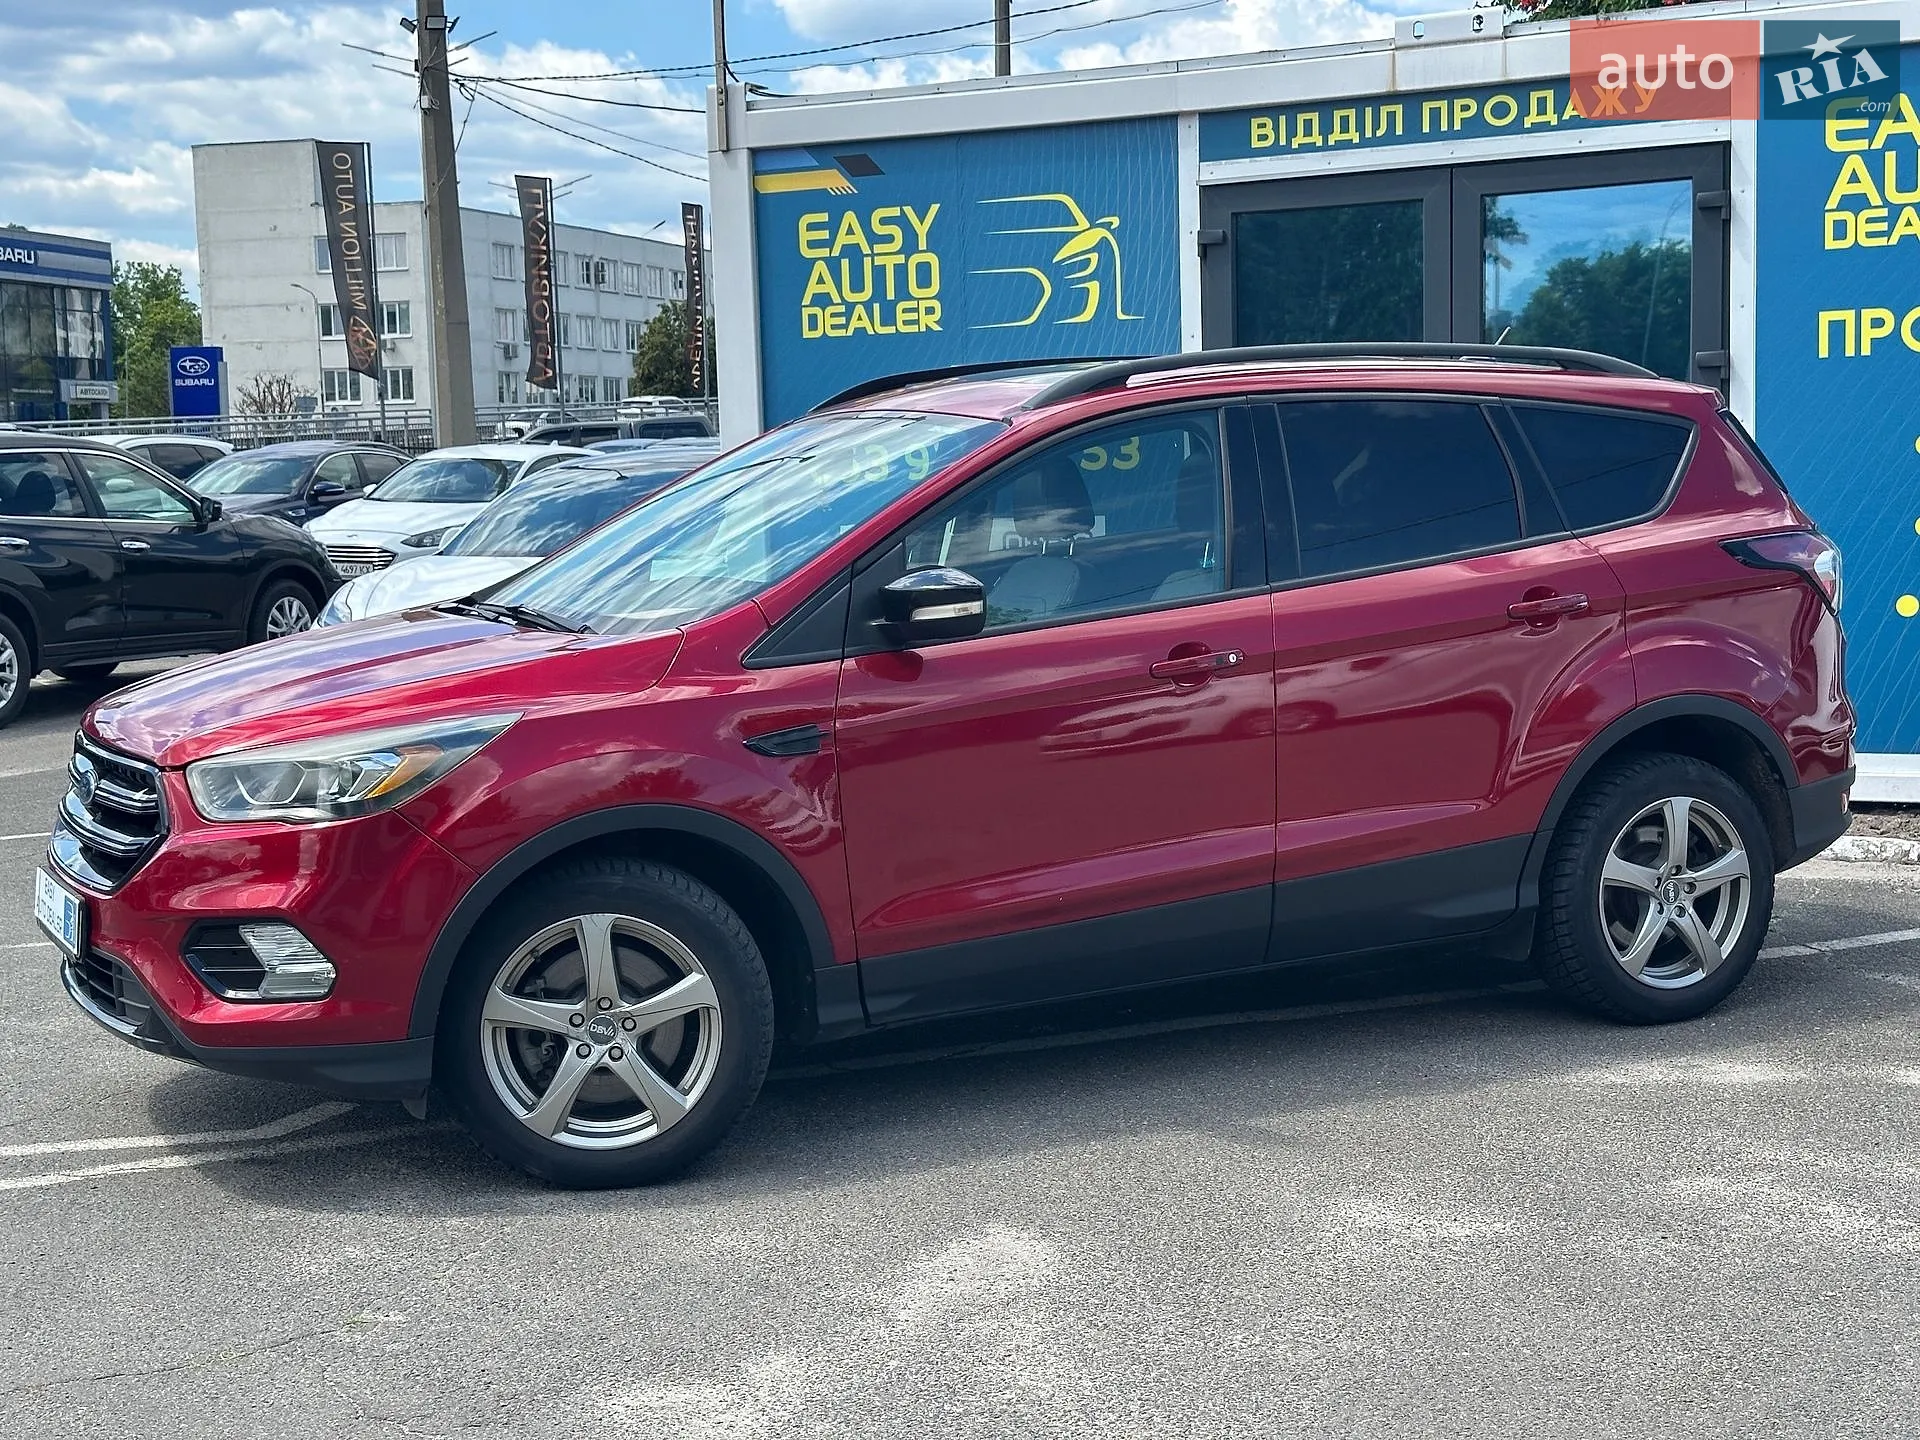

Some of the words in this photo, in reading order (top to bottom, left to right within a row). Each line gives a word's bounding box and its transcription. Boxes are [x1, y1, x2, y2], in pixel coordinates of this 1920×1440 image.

[1250, 103, 1403, 149] ВІДДІЛ
[1422, 81, 1659, 134] ПРОДАЖУ
[798, 202, 941, 259] EASY
[802, 251, 940, 306] AUTO
[802, 299, 943, 339] DEALER
[174, 378, 214, 387] SUBARU
